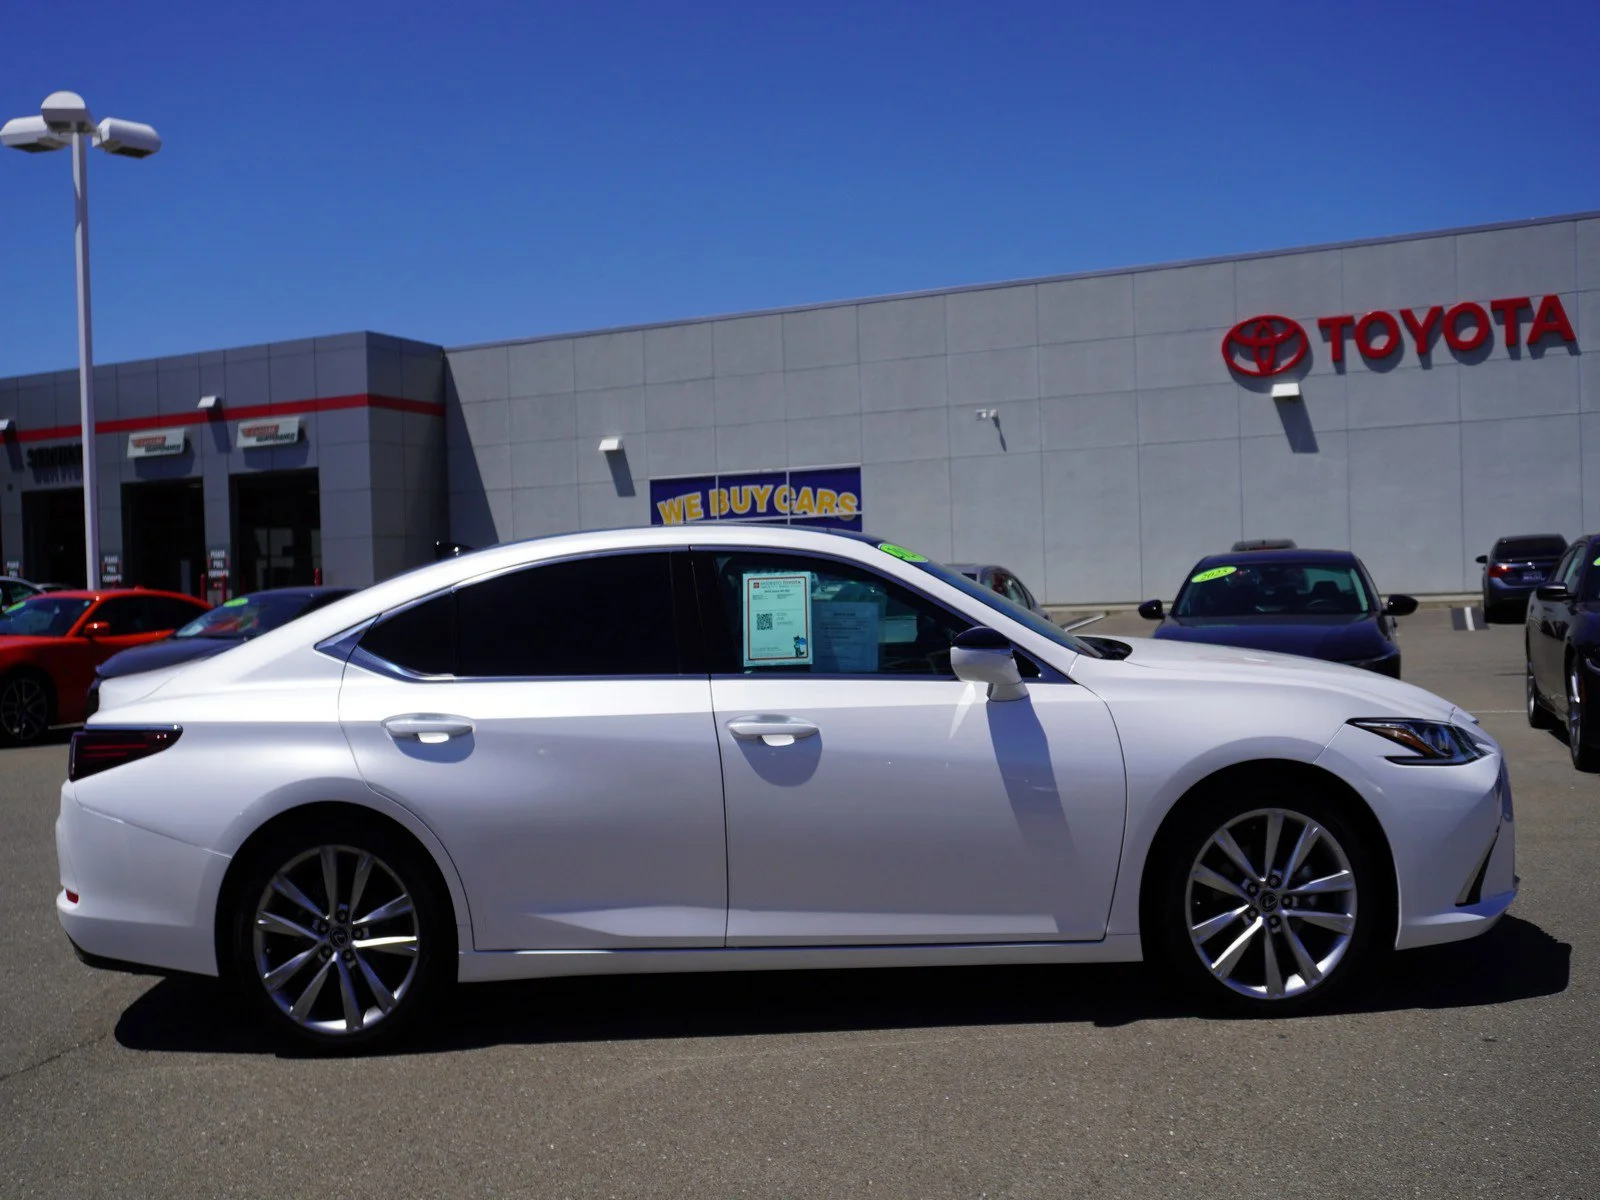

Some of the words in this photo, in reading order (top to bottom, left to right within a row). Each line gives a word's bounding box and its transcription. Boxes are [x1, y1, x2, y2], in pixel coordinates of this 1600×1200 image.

[1318, 294, 1576, 362] TOYOTA
[656, 491, 704, 525] WE
[708, 484, 774, 517] BUY
[773, 484, 859, 521] CARS
